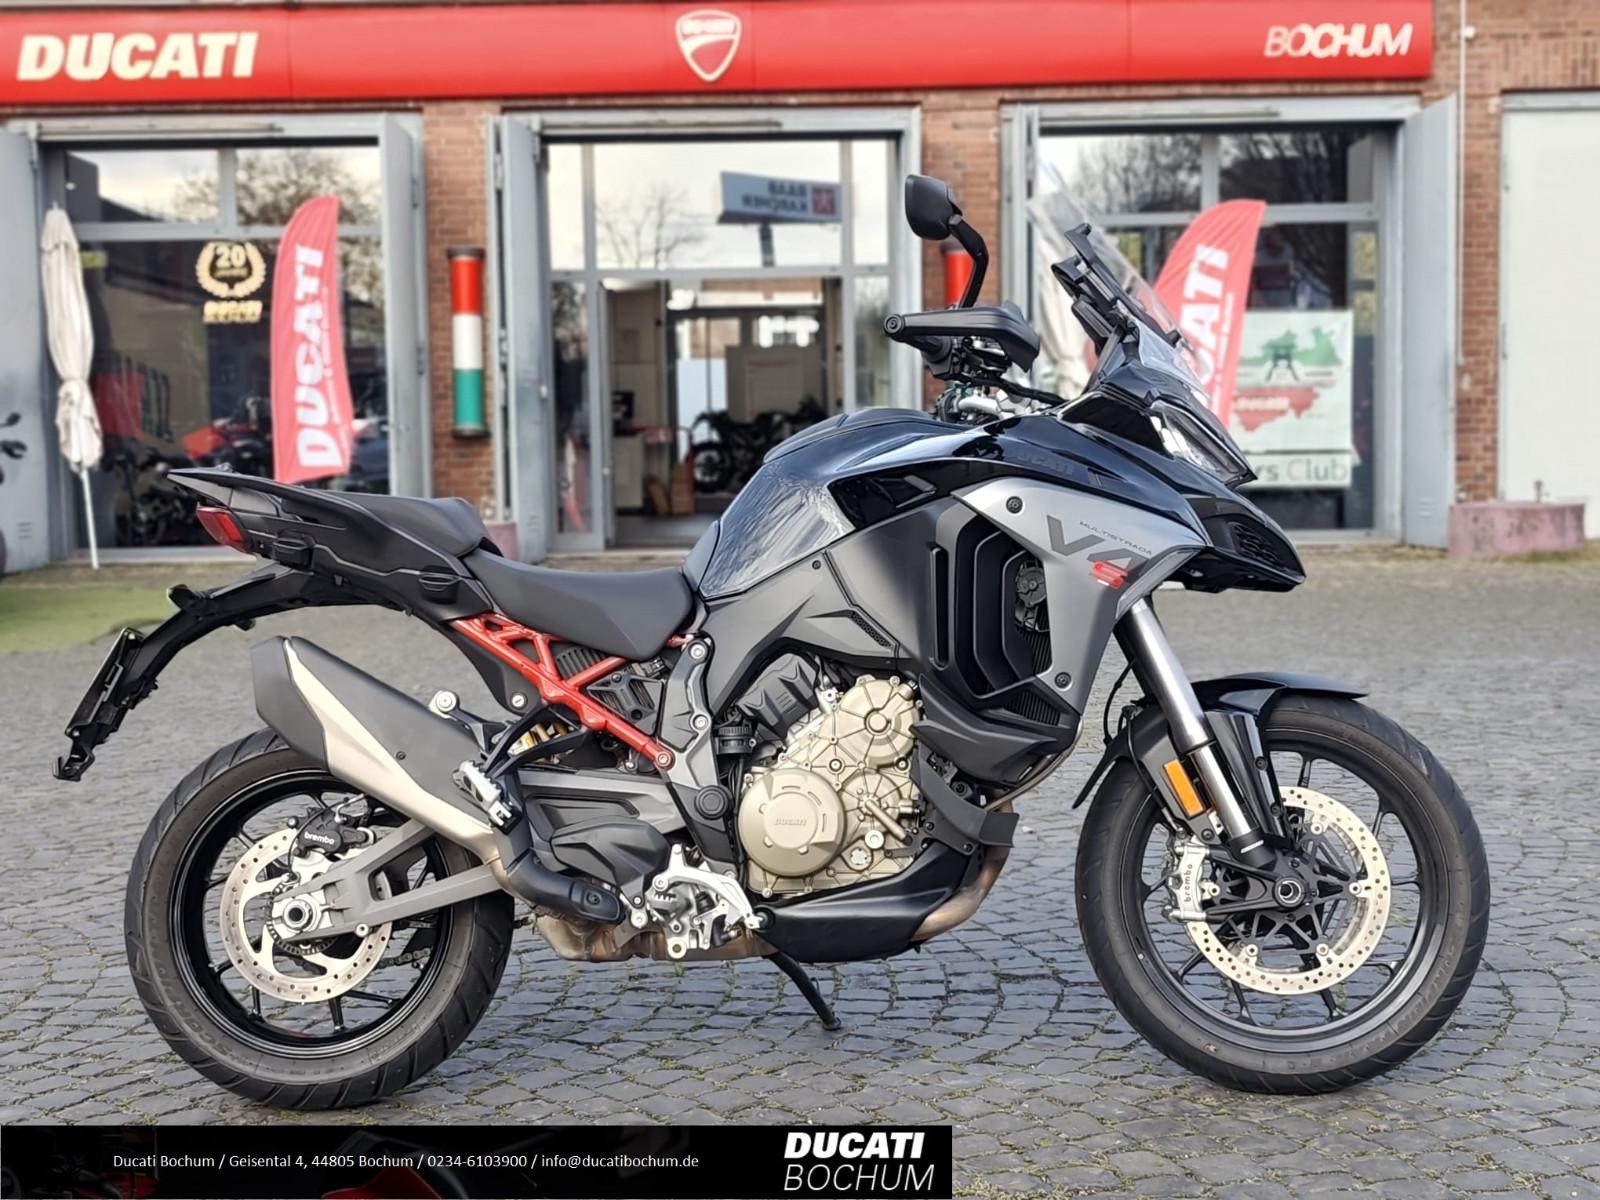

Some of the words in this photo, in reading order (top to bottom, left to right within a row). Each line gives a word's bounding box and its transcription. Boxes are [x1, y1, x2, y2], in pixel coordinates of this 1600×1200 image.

[17, 32, 259, 81] DUCATI
[1264, 22, 1414, 58] BOCHUM
[215, 244, 246, 268] 20
[294, 244, 344, 467] DUCATI
[1286, 458, 1348, 482] Club
[1079, 521, 1152, 555] MULTISTRADA
[304, 831, 335, 845] brembo
[1183, 863, 1194, 903] brembo
